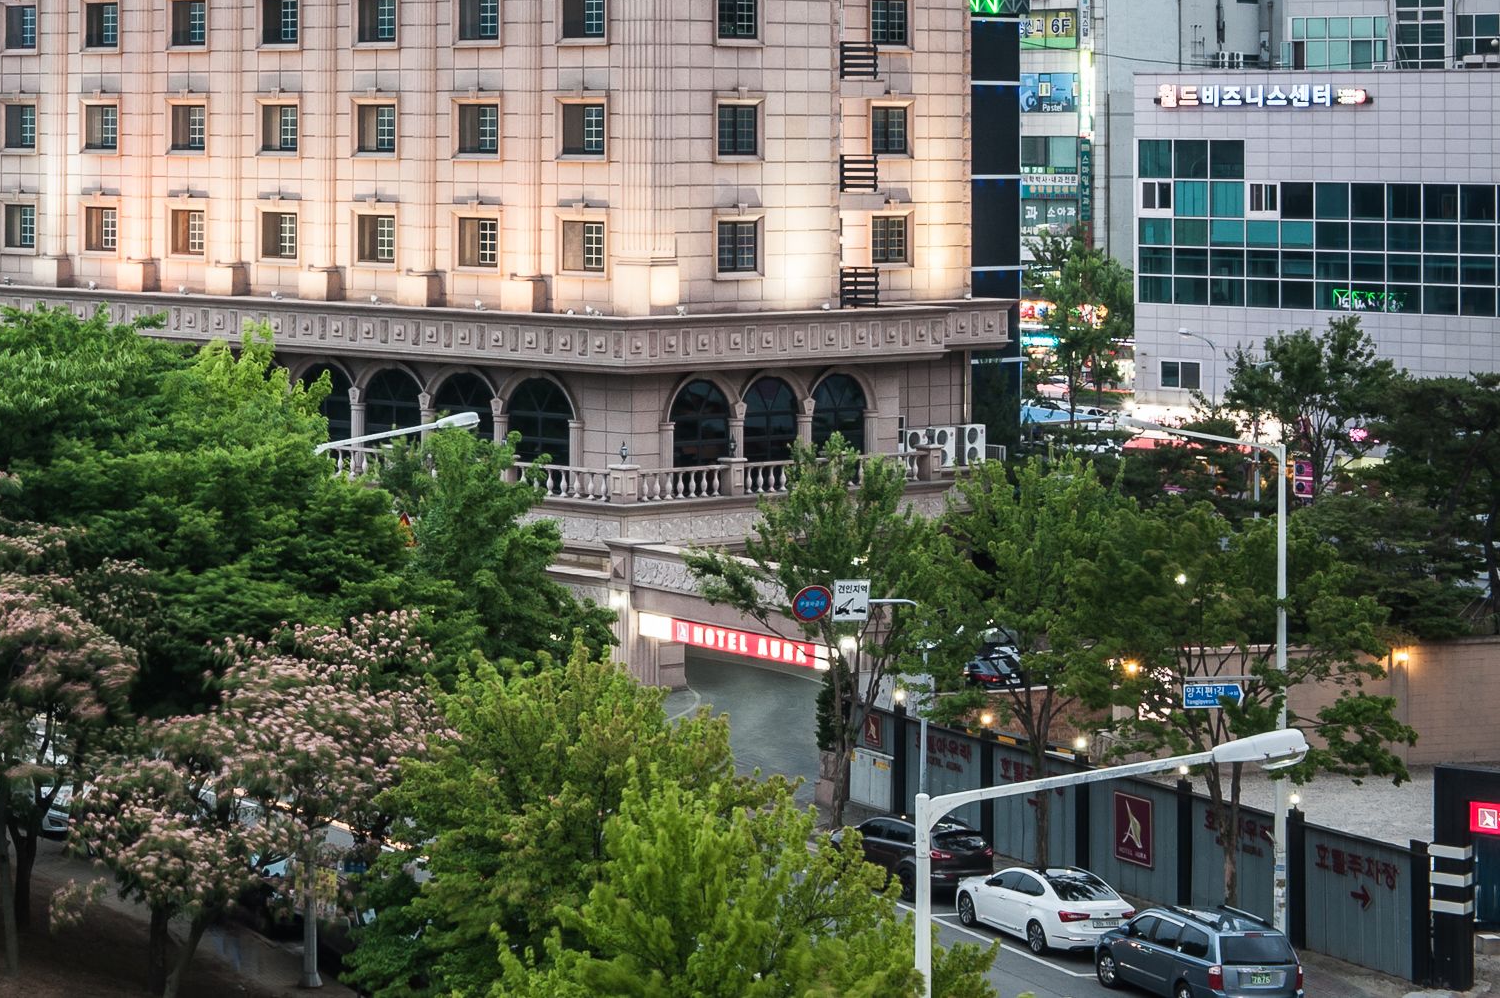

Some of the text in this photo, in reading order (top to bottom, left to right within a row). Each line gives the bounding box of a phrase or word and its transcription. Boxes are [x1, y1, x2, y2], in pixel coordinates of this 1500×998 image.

[1051, 18, 1071, 34] 6F
[1042, 103, 1063, 112] Pastel
[1046, 206, 1077, 218] 소아과
[837, 584, 868, 594] 견인지역
[693, 626, 808, 664] HOTEL AURA
